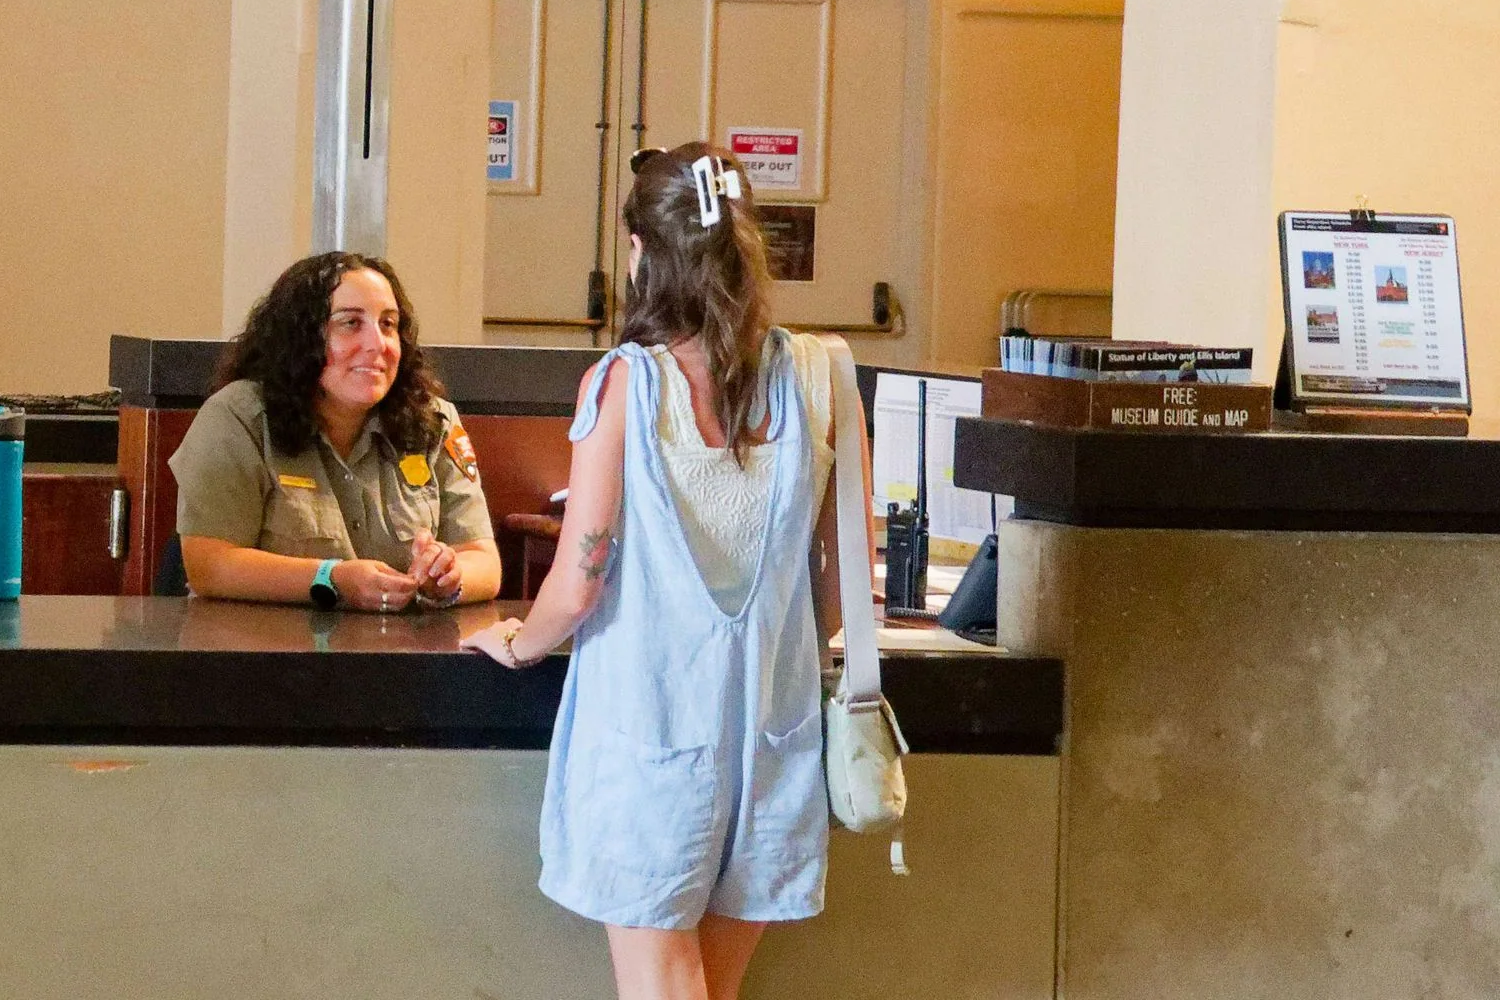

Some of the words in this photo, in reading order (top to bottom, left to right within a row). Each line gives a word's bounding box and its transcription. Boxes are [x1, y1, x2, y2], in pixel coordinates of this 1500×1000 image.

[736, 135, 792, 145] RESTRICTED
[752, 145, 777, 153] AREA
[489, 153, 507, 163] UT
[742, 161, 765, 171] EEP
[768, 161, 793, 171] OUT
[1108, 353, 1135, 362] Statue
[1137, 352, 1147, 361] of
[1148, 352, 1176, 362] Liberty
[1179, 351, 1196, 360] and
[1197, 351, 1213, 360] Ellis
[1215, 351, 1241, 360] Island
[1163, 387, 1198, 405] FREE:
[1111, 408, 1159, 426] MUSEUM
[1164, 409, 1199, 426] GUIDE
[1202, 413, 1221, 427] AND
[1225, 410, 1249, 427] MAP
